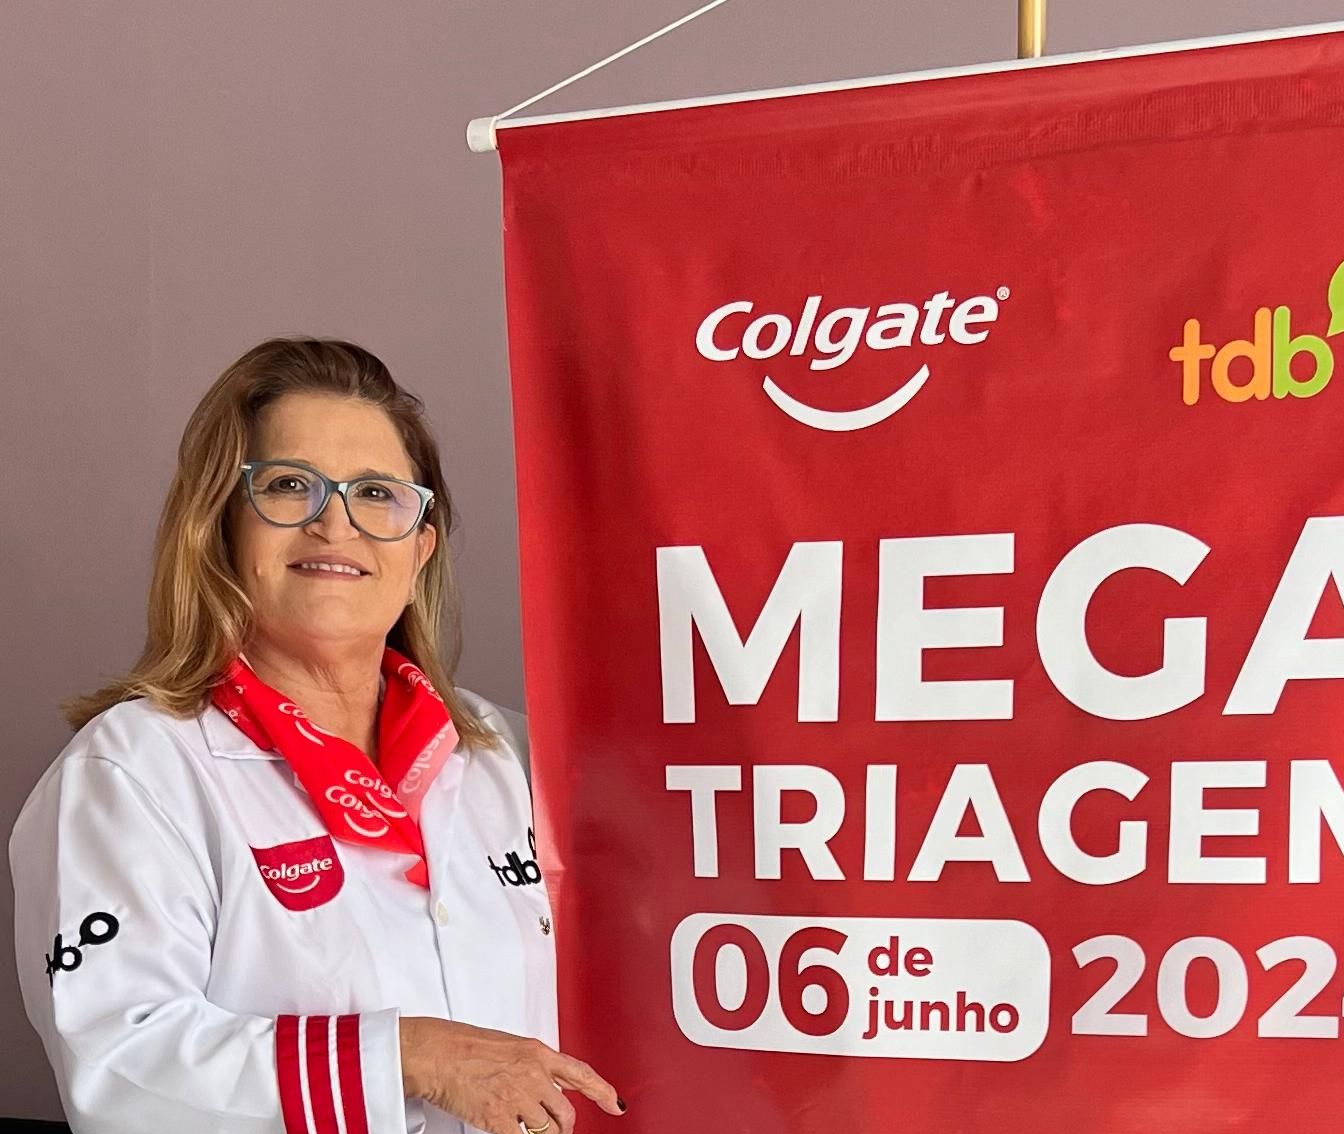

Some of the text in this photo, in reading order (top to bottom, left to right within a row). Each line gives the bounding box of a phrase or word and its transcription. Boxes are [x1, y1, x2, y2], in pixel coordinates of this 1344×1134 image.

[1170, 306, 1334, 405] tdb
[260, 858, 332, 881] Colgate
[487, 851, 542, 886] tdb
[868, 936, 933, 977] de
[693, 924, 849, 1036] 06
[862, 987, 1019, 1039] junho
